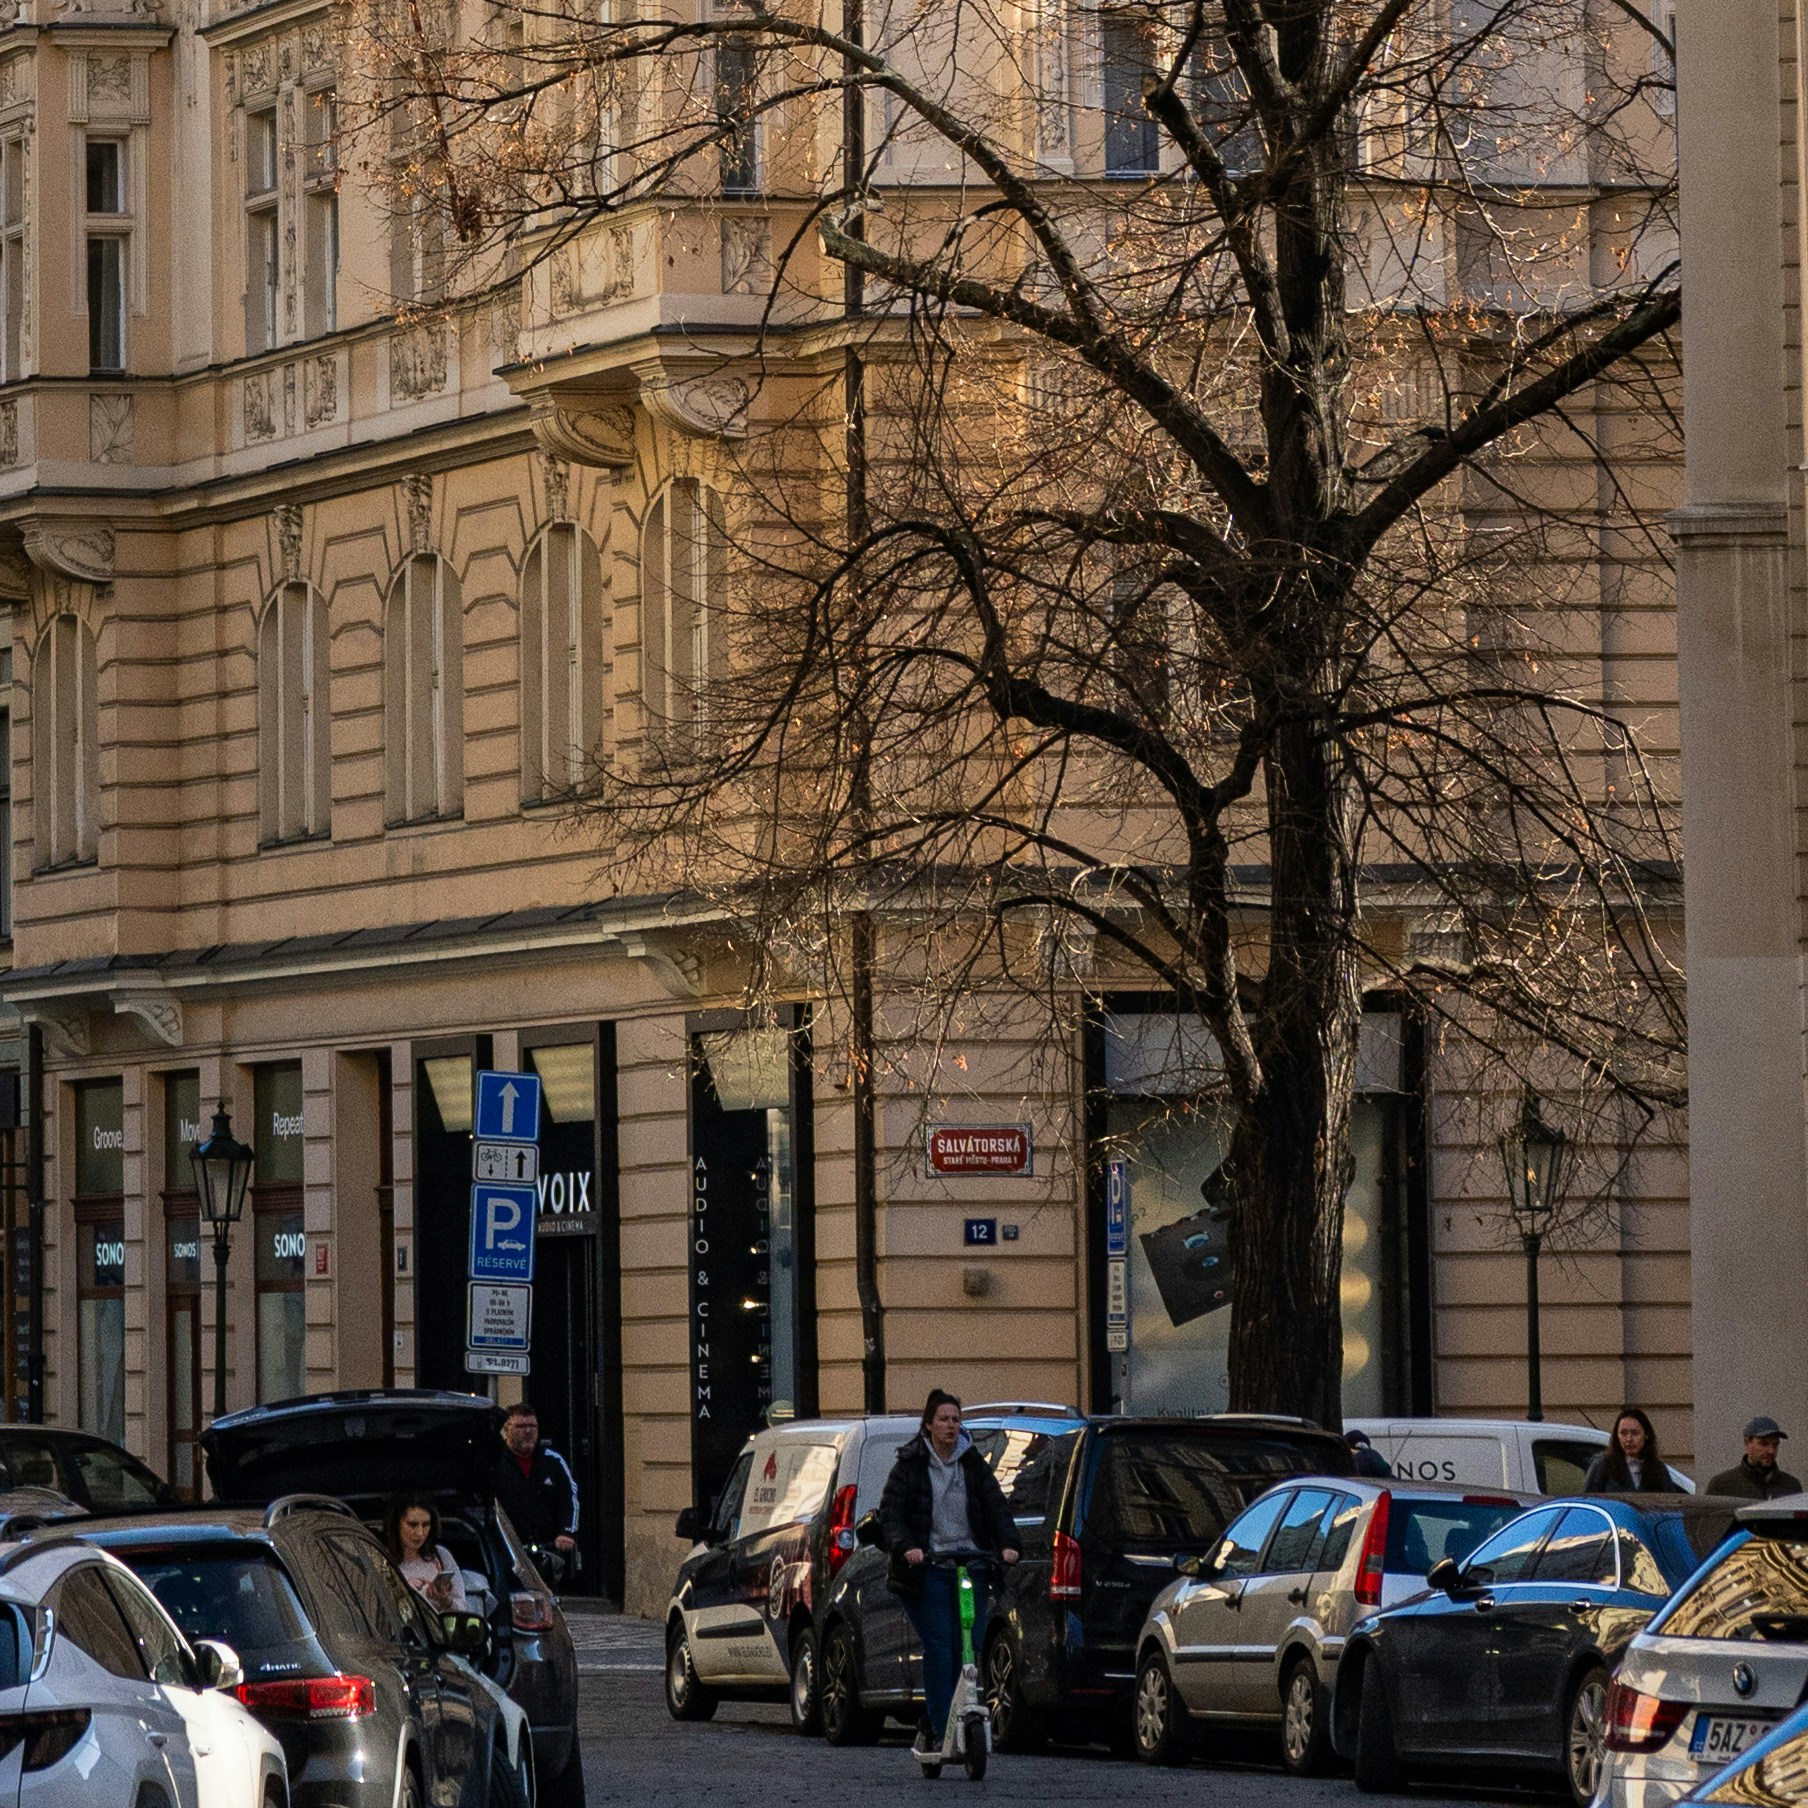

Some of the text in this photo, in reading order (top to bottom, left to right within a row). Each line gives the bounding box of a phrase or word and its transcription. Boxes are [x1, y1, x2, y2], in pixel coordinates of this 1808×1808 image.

[937, 1135, 1021, 1153] SALVÁTORSKÁ
[537, 1171, 591, 1215] VOIX
[972, 1224, 988, 1239] 12
[476, 1254, 527, 1271] RÉSERVÉ
[695, 1156, 711, 1419] AUDIO & CINEMA
[1396, 1460, 1456, 1481] NOS
